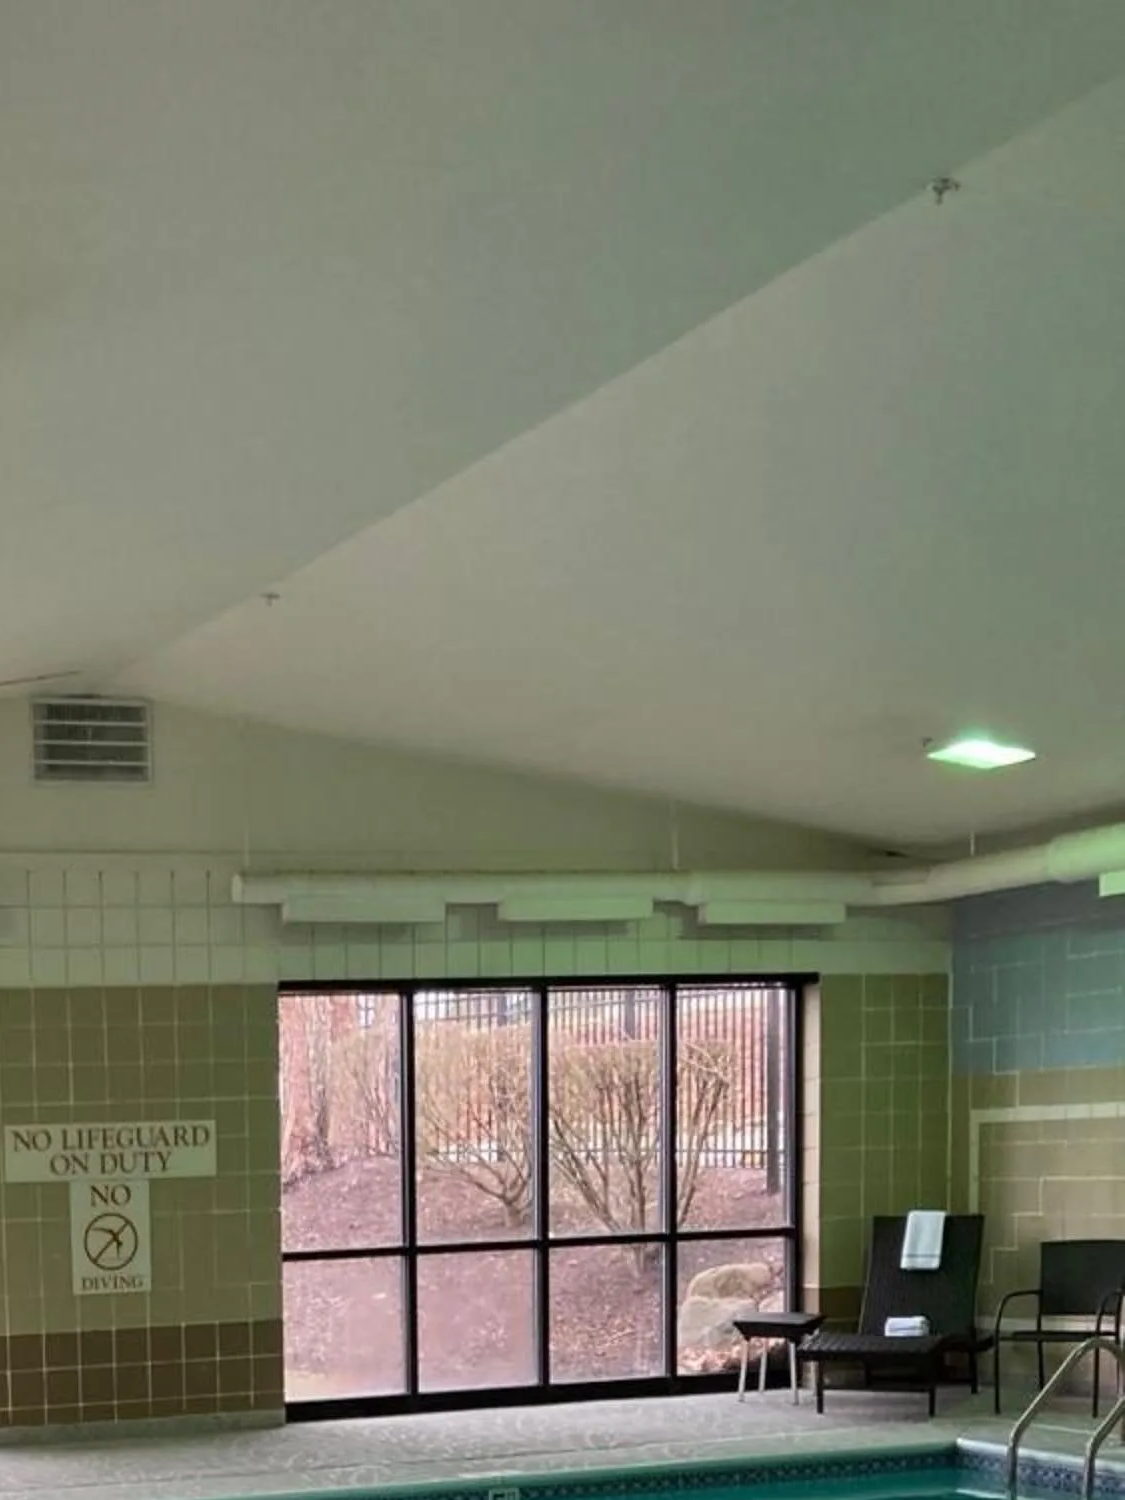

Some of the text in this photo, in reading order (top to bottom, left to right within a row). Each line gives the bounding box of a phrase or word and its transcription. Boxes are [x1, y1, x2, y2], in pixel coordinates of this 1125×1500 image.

[11, 1125, 210, 1152] NO LIFEGUARD
[50, 1151, 173, 1176] ON DUTY
[90, 1183, 132, 1207] NO
[81, 1274, 144, 1291] DIVING
